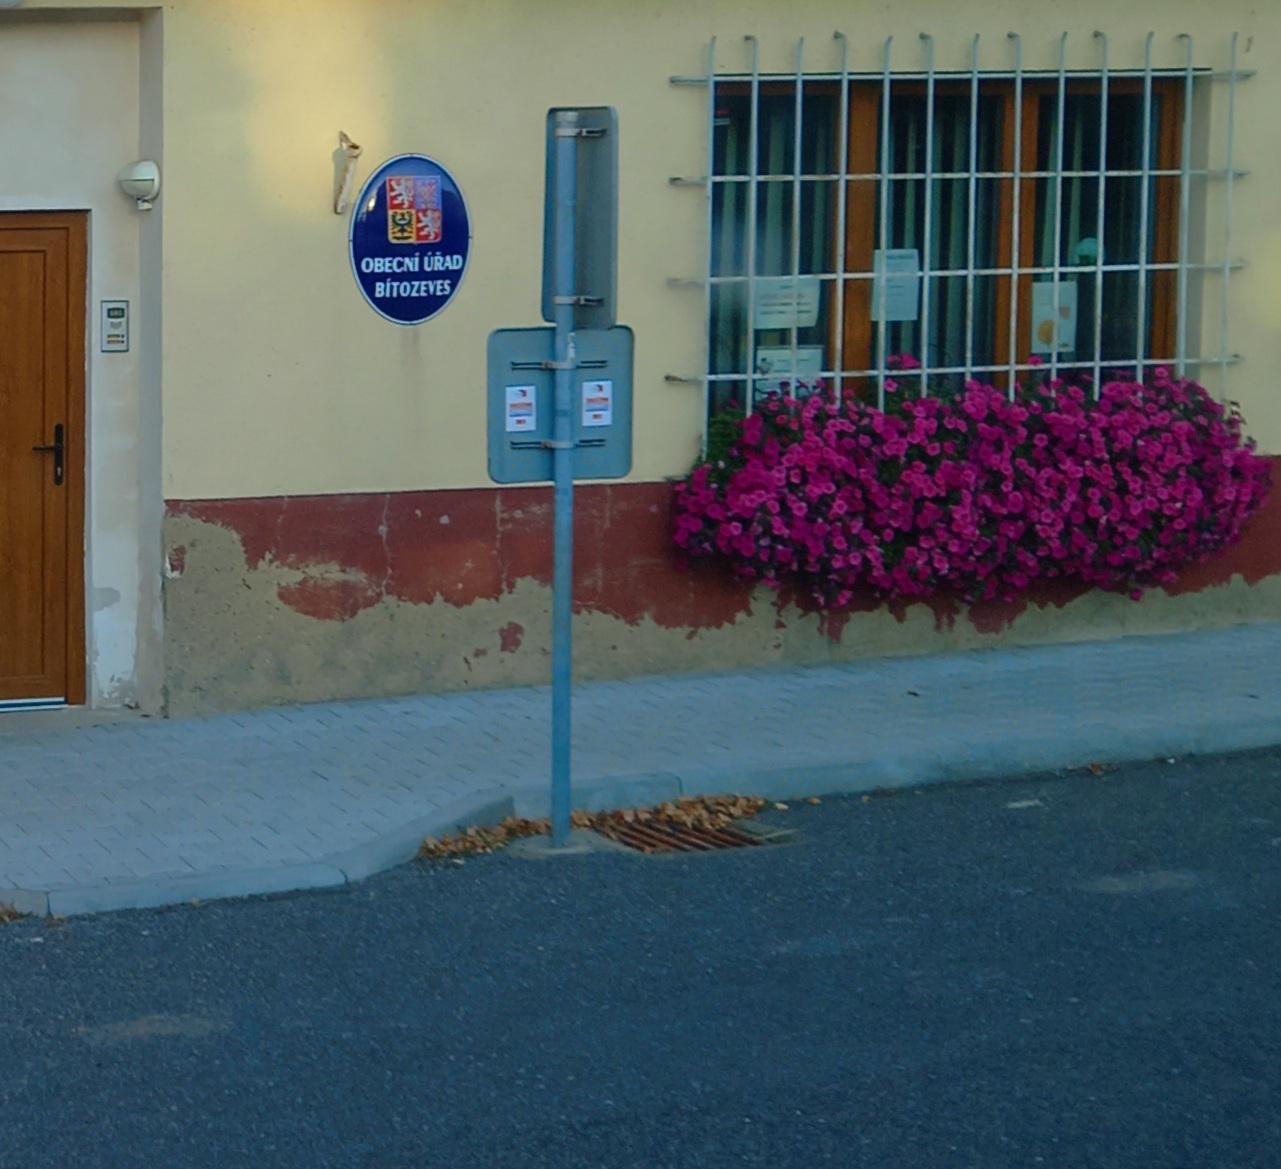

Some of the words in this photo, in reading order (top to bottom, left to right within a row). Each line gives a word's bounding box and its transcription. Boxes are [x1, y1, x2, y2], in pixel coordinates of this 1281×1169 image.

[360, 252, 420, 273] OBECNÍ
[423, 251, 464, 272] ÚŘAD
[374, 278, 452, 298] BÍTOZEVES
